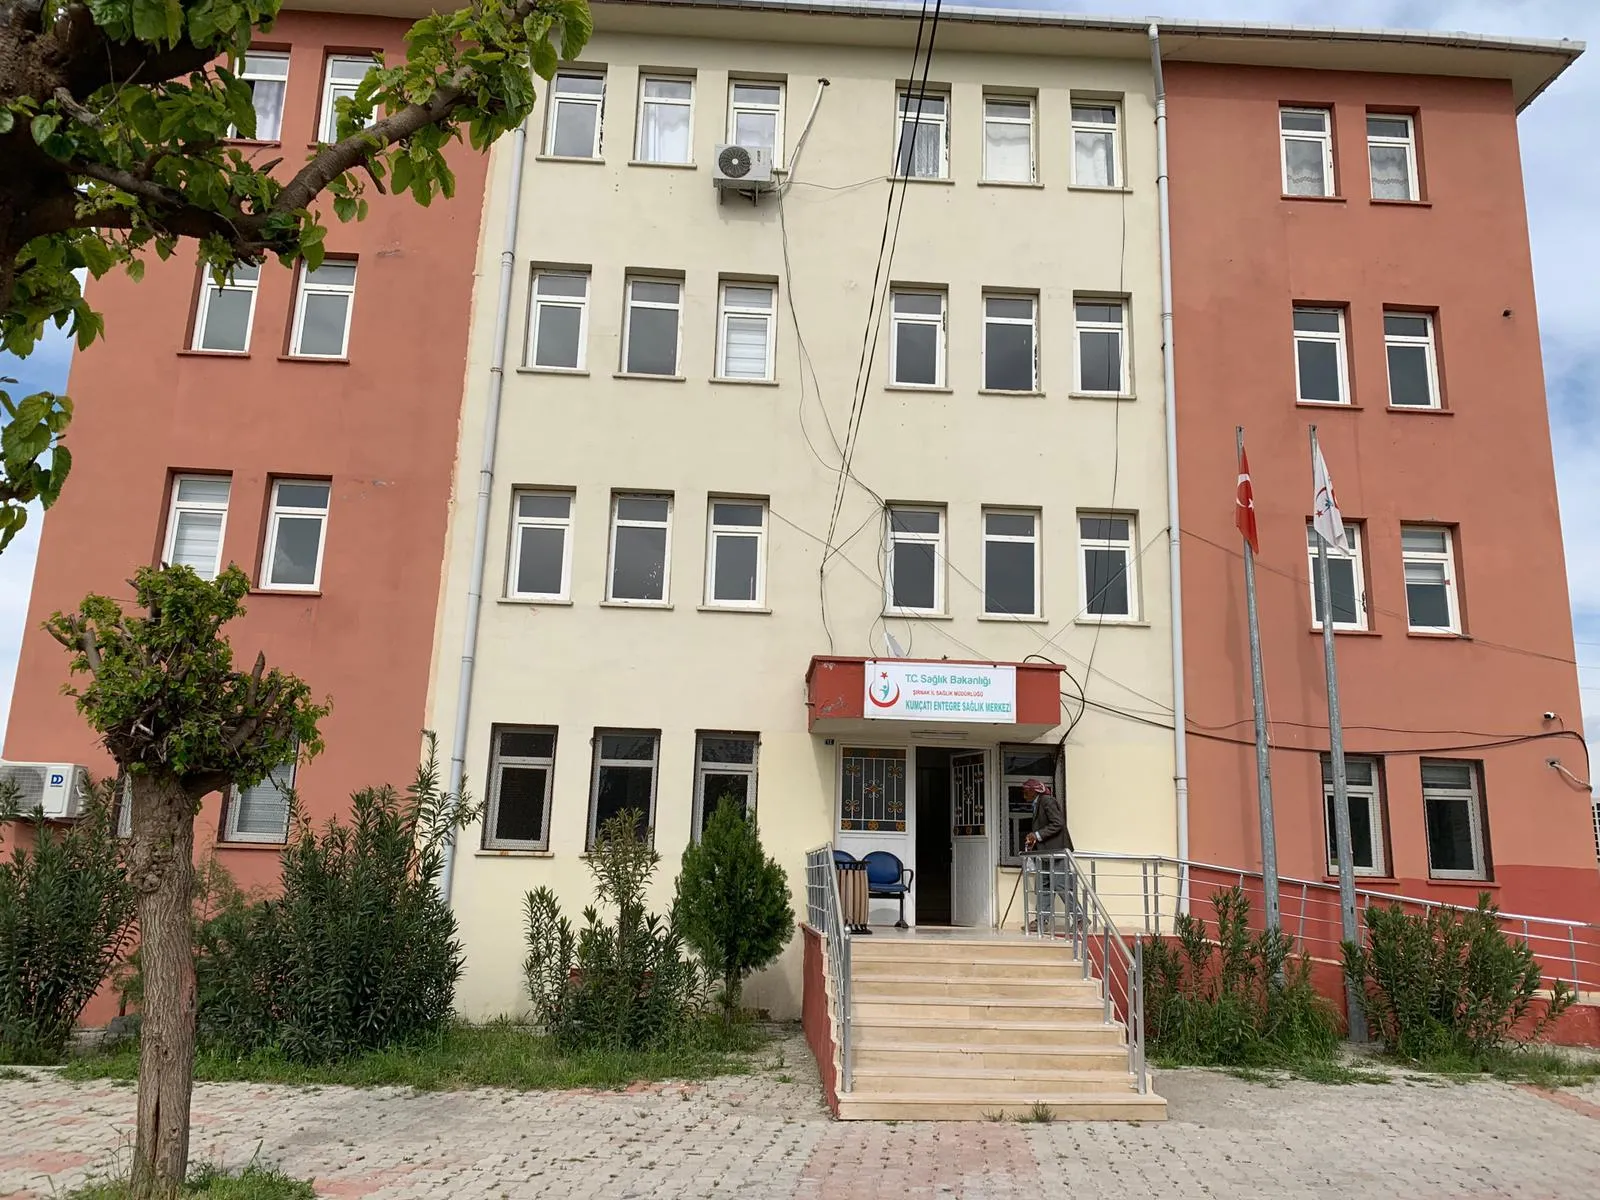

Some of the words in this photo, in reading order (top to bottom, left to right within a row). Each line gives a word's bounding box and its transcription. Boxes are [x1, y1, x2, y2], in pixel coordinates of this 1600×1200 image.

[920, 674, 947, 686] Sağlık
[950, 675, 991, 687] Bakanlığı
[906, 700, 933, 712] KUMÇATI
[934, 701, 961, 712] ENTEGRE
[962, 701, 985, 713] SAĞLIK
[986, 702, 1012, 713] MERKEZİ
